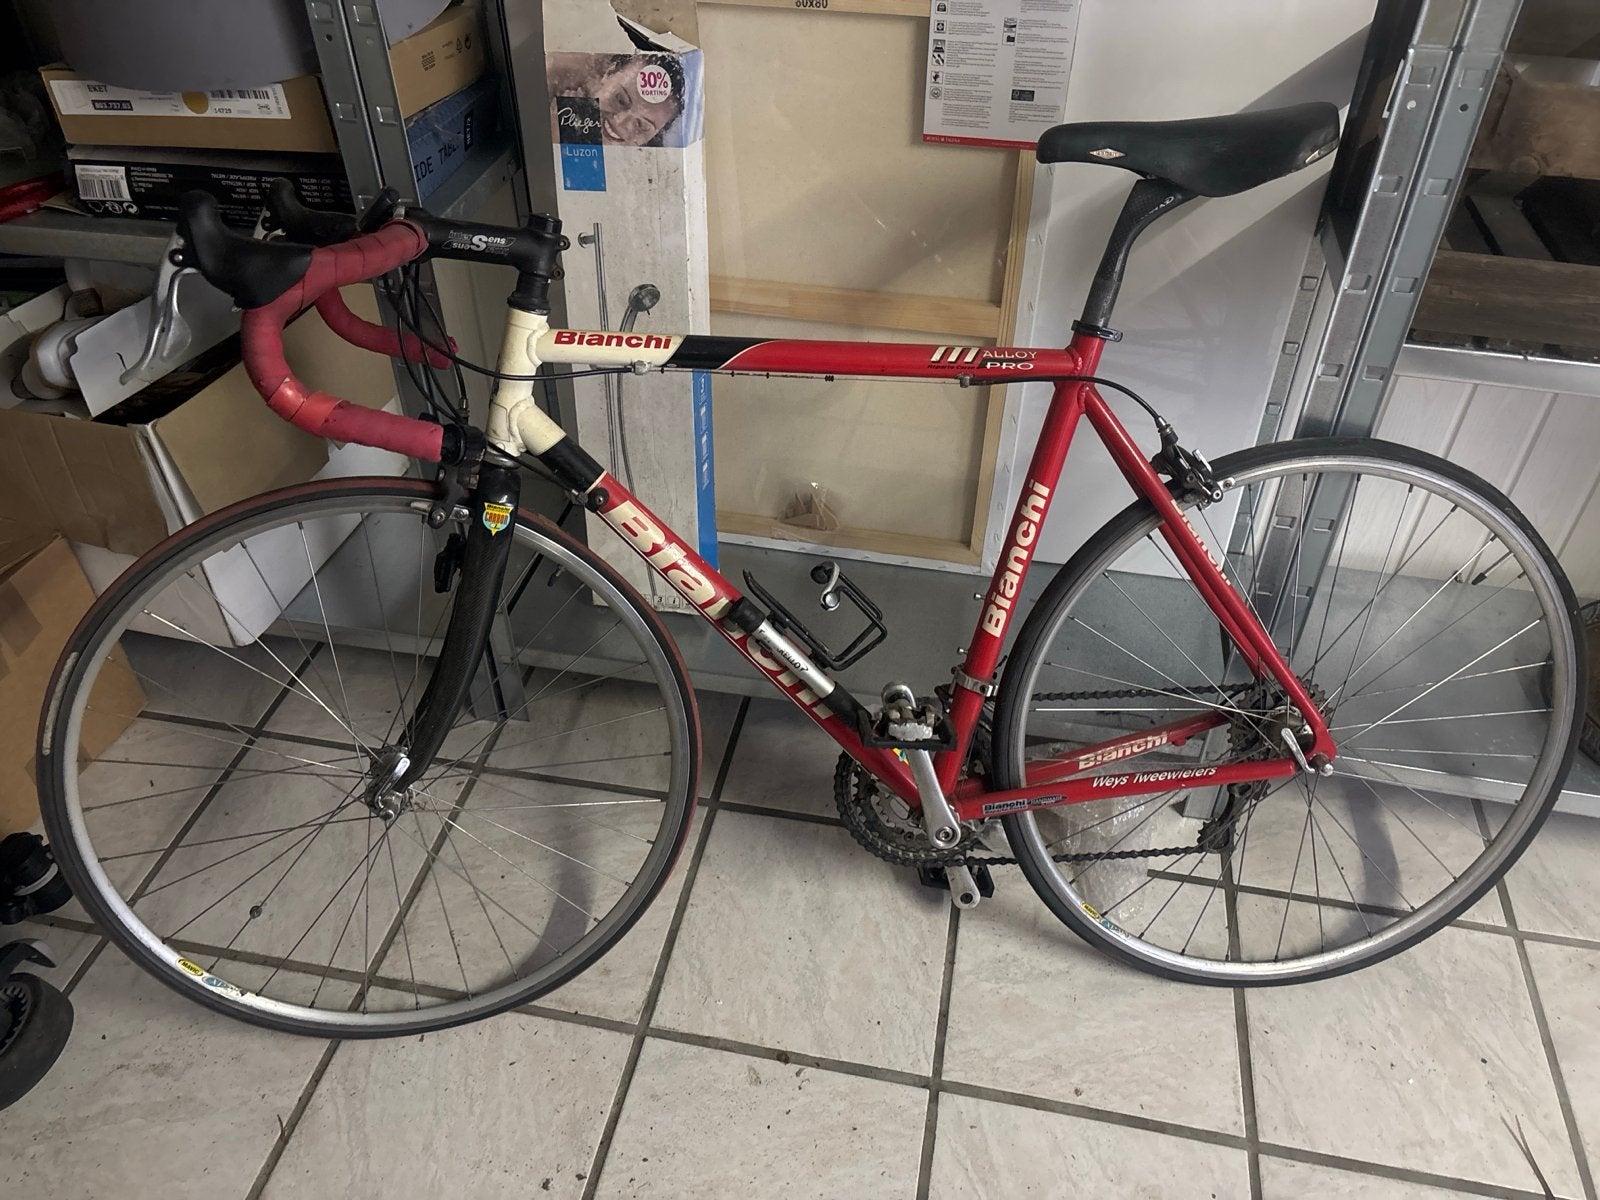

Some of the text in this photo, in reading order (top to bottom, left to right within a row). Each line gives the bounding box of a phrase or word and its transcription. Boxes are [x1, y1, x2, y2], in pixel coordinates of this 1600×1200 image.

[639, 71, 669, 89] 30%
[86, 84, 108, 93] EKET
[557, 106, 602, 134] Plieger
[566, 146, 598, 157] Luzon
[413, 143, 460, 182] IDE TABL
[553, 331, 673, 350] Bianchi
[982, 350, 1037, 359] ALLOY
[985, 362, 1034, 370] PRO
[982, 479, 1050, 638] Bianchi
[1078, 731, 1168, 770] Bianchi
[1092, 774, 1130, 789] Weys
[984, 800, 1026, 811] Bianchi
[181, 960, 200, 974] MAVIC
